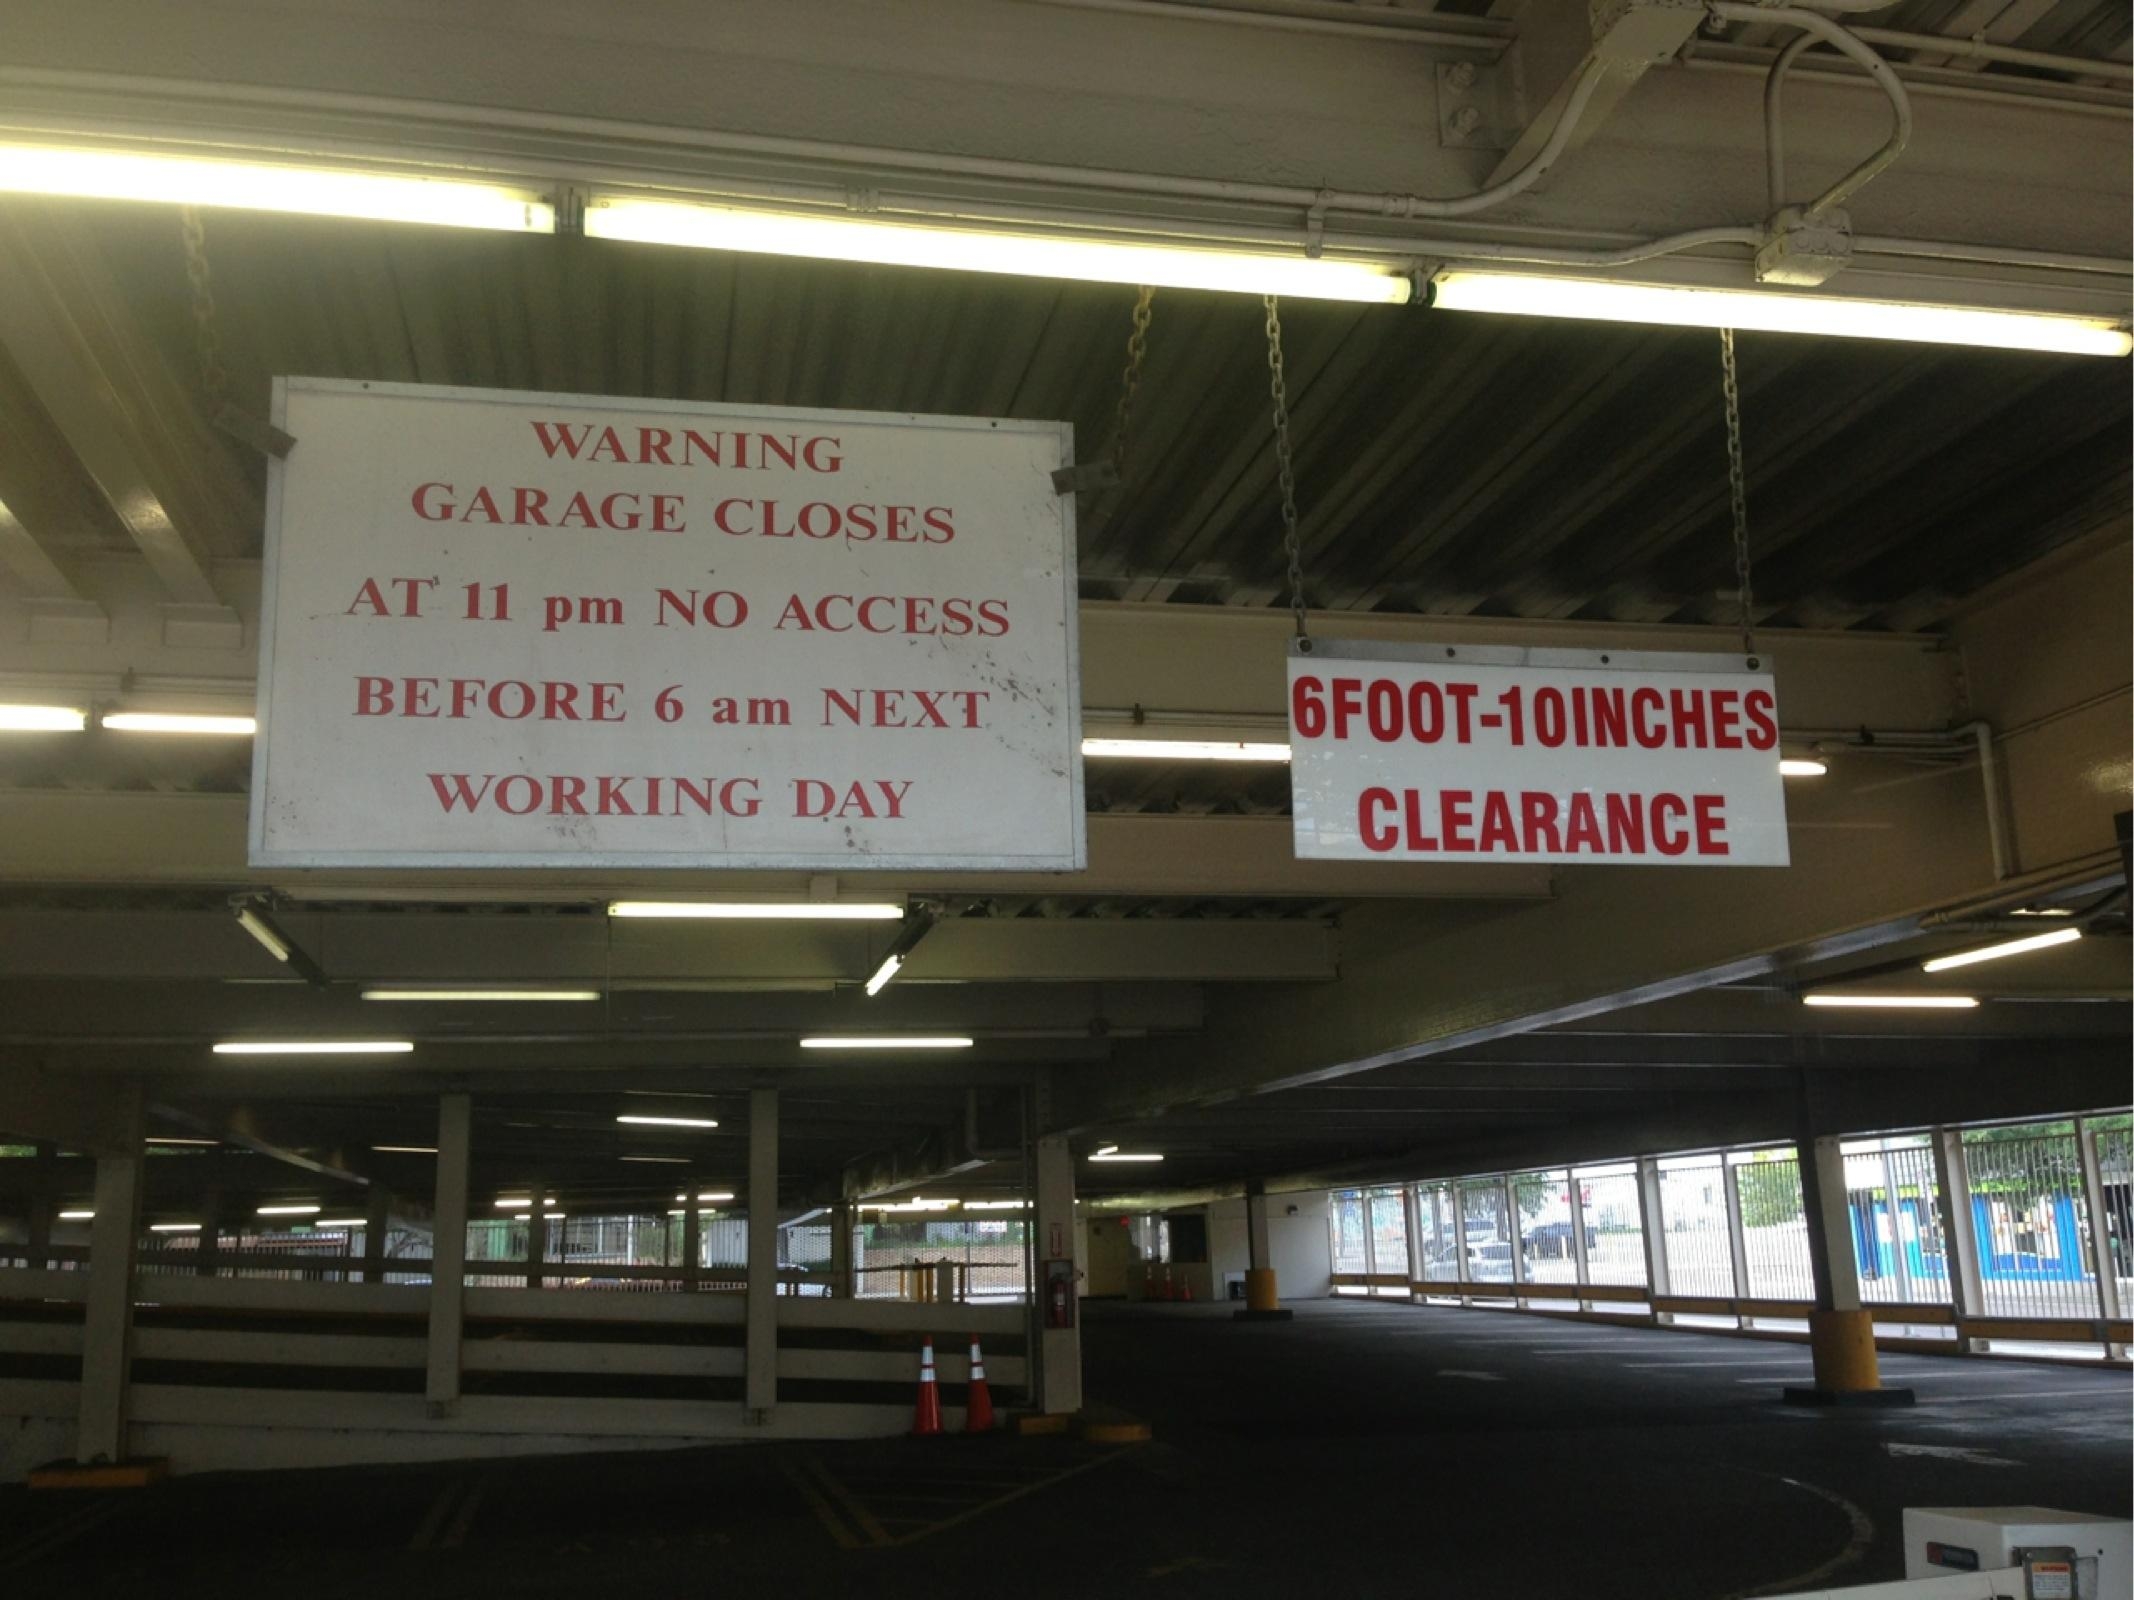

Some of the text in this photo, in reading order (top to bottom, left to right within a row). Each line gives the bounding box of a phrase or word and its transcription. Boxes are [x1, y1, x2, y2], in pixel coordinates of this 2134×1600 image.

[530, 421, 843, 474] WARNING
[411, 482, 956, 544] GARAGE CLOSES
[344, 577, 1011, 636] AT 11 pm NO ACCESS
[352, 676, 989, 729] BEFORE 6 am NEXT
[426, 773, 913, 819] WORKING DAY
[1358, 786, 1731, 857] CLEARANCE
